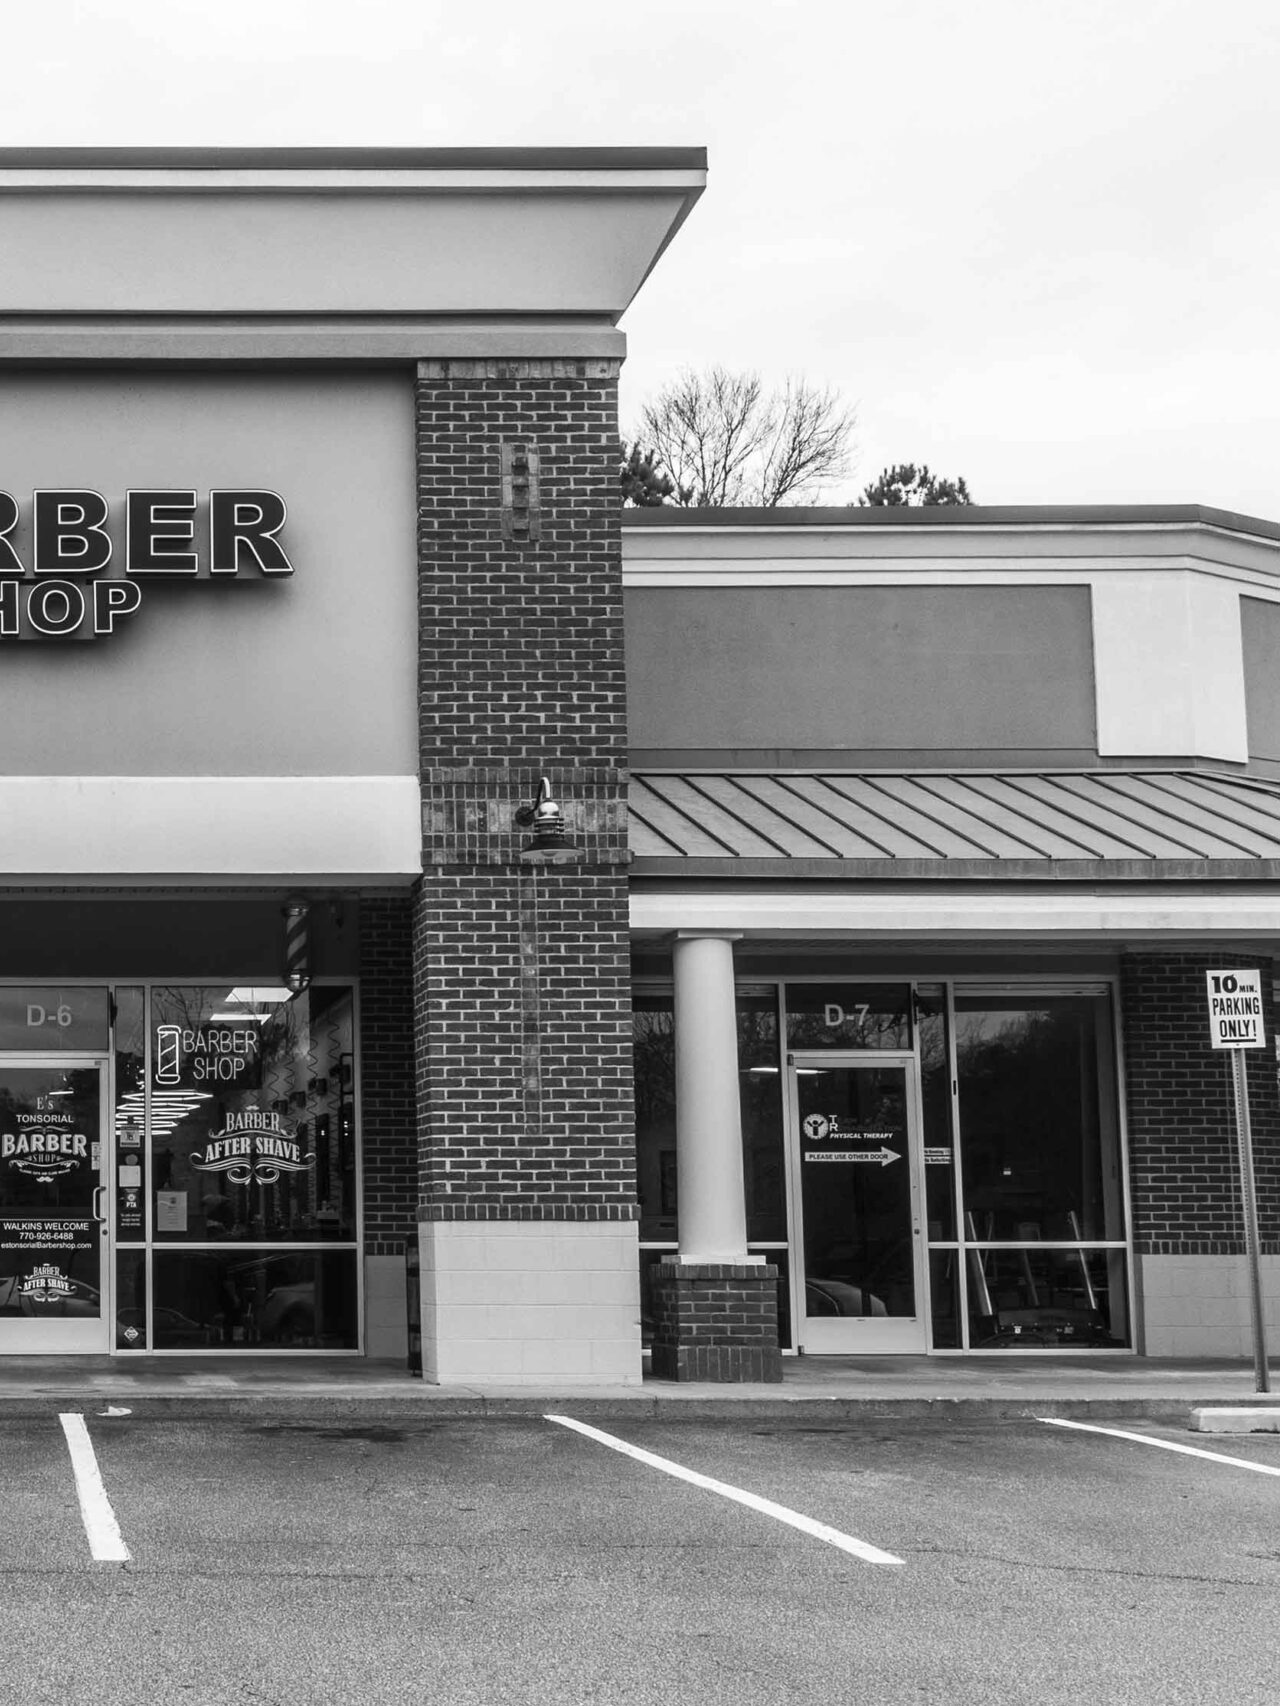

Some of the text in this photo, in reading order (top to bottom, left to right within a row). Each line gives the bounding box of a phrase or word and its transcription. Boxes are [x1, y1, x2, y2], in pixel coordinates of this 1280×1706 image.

[1211, 975, 1258, 994] 10 MIN.
[27, 1004, 72, 1027] D-6
[825, 1004, 870, 1026] D-7
[1212, 997, 1260, 1016] PARKING
[1220, 1019, 1257, 1038] ONLY!
[182, 1029, 258, 1053] BARBER
[193, 1057, 245, 1080] SHOP
[15, 1114, 75, 1123] TONSORIAL
[226, 1111, 280, 1132] BARBER
[1, 1133, 88, 1158] BARBER
[205, 1137, 301, 1163] AFTER SHAVE
[3, 1222, 90, 1231] WALKINS WELCOME
[19, 1232, 74, 1240] 770-926-6488
[33, 1266, 61, 1276] BARBER
[23, 1278, 70, 1292] AFTER SHAVE
